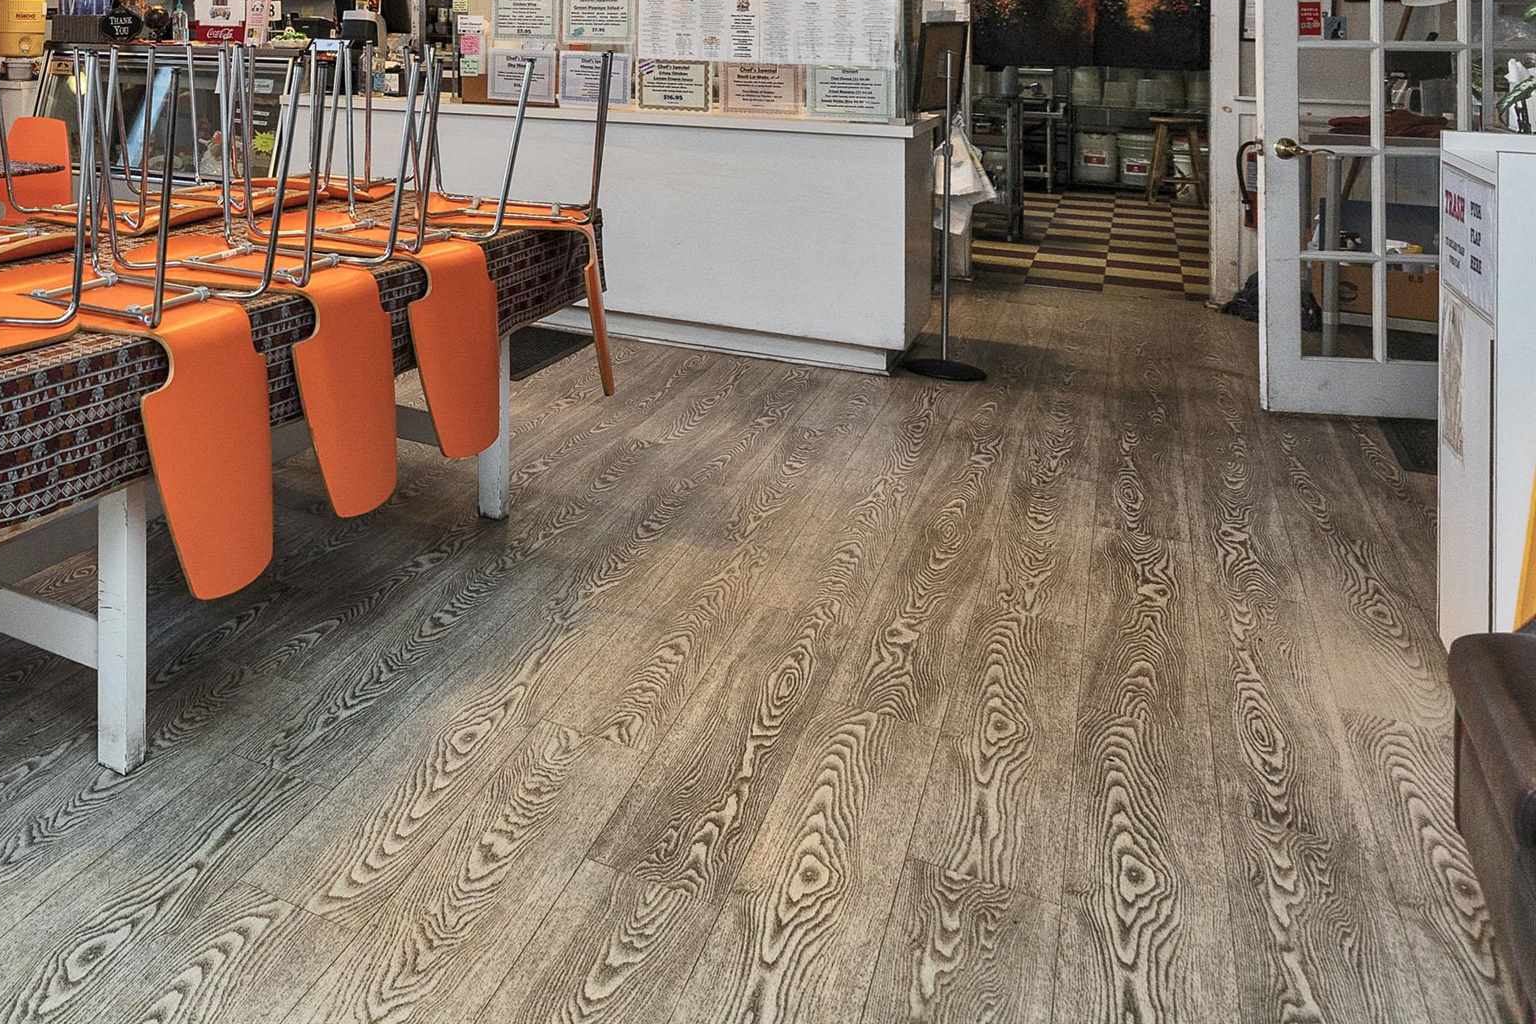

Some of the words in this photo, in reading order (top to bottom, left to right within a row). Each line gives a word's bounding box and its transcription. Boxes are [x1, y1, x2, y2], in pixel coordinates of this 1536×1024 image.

[108, 16, 133, 25] THANK
[113, 25, 129, 36] YOU
[1445, 189, 1465, 224] TRASH
